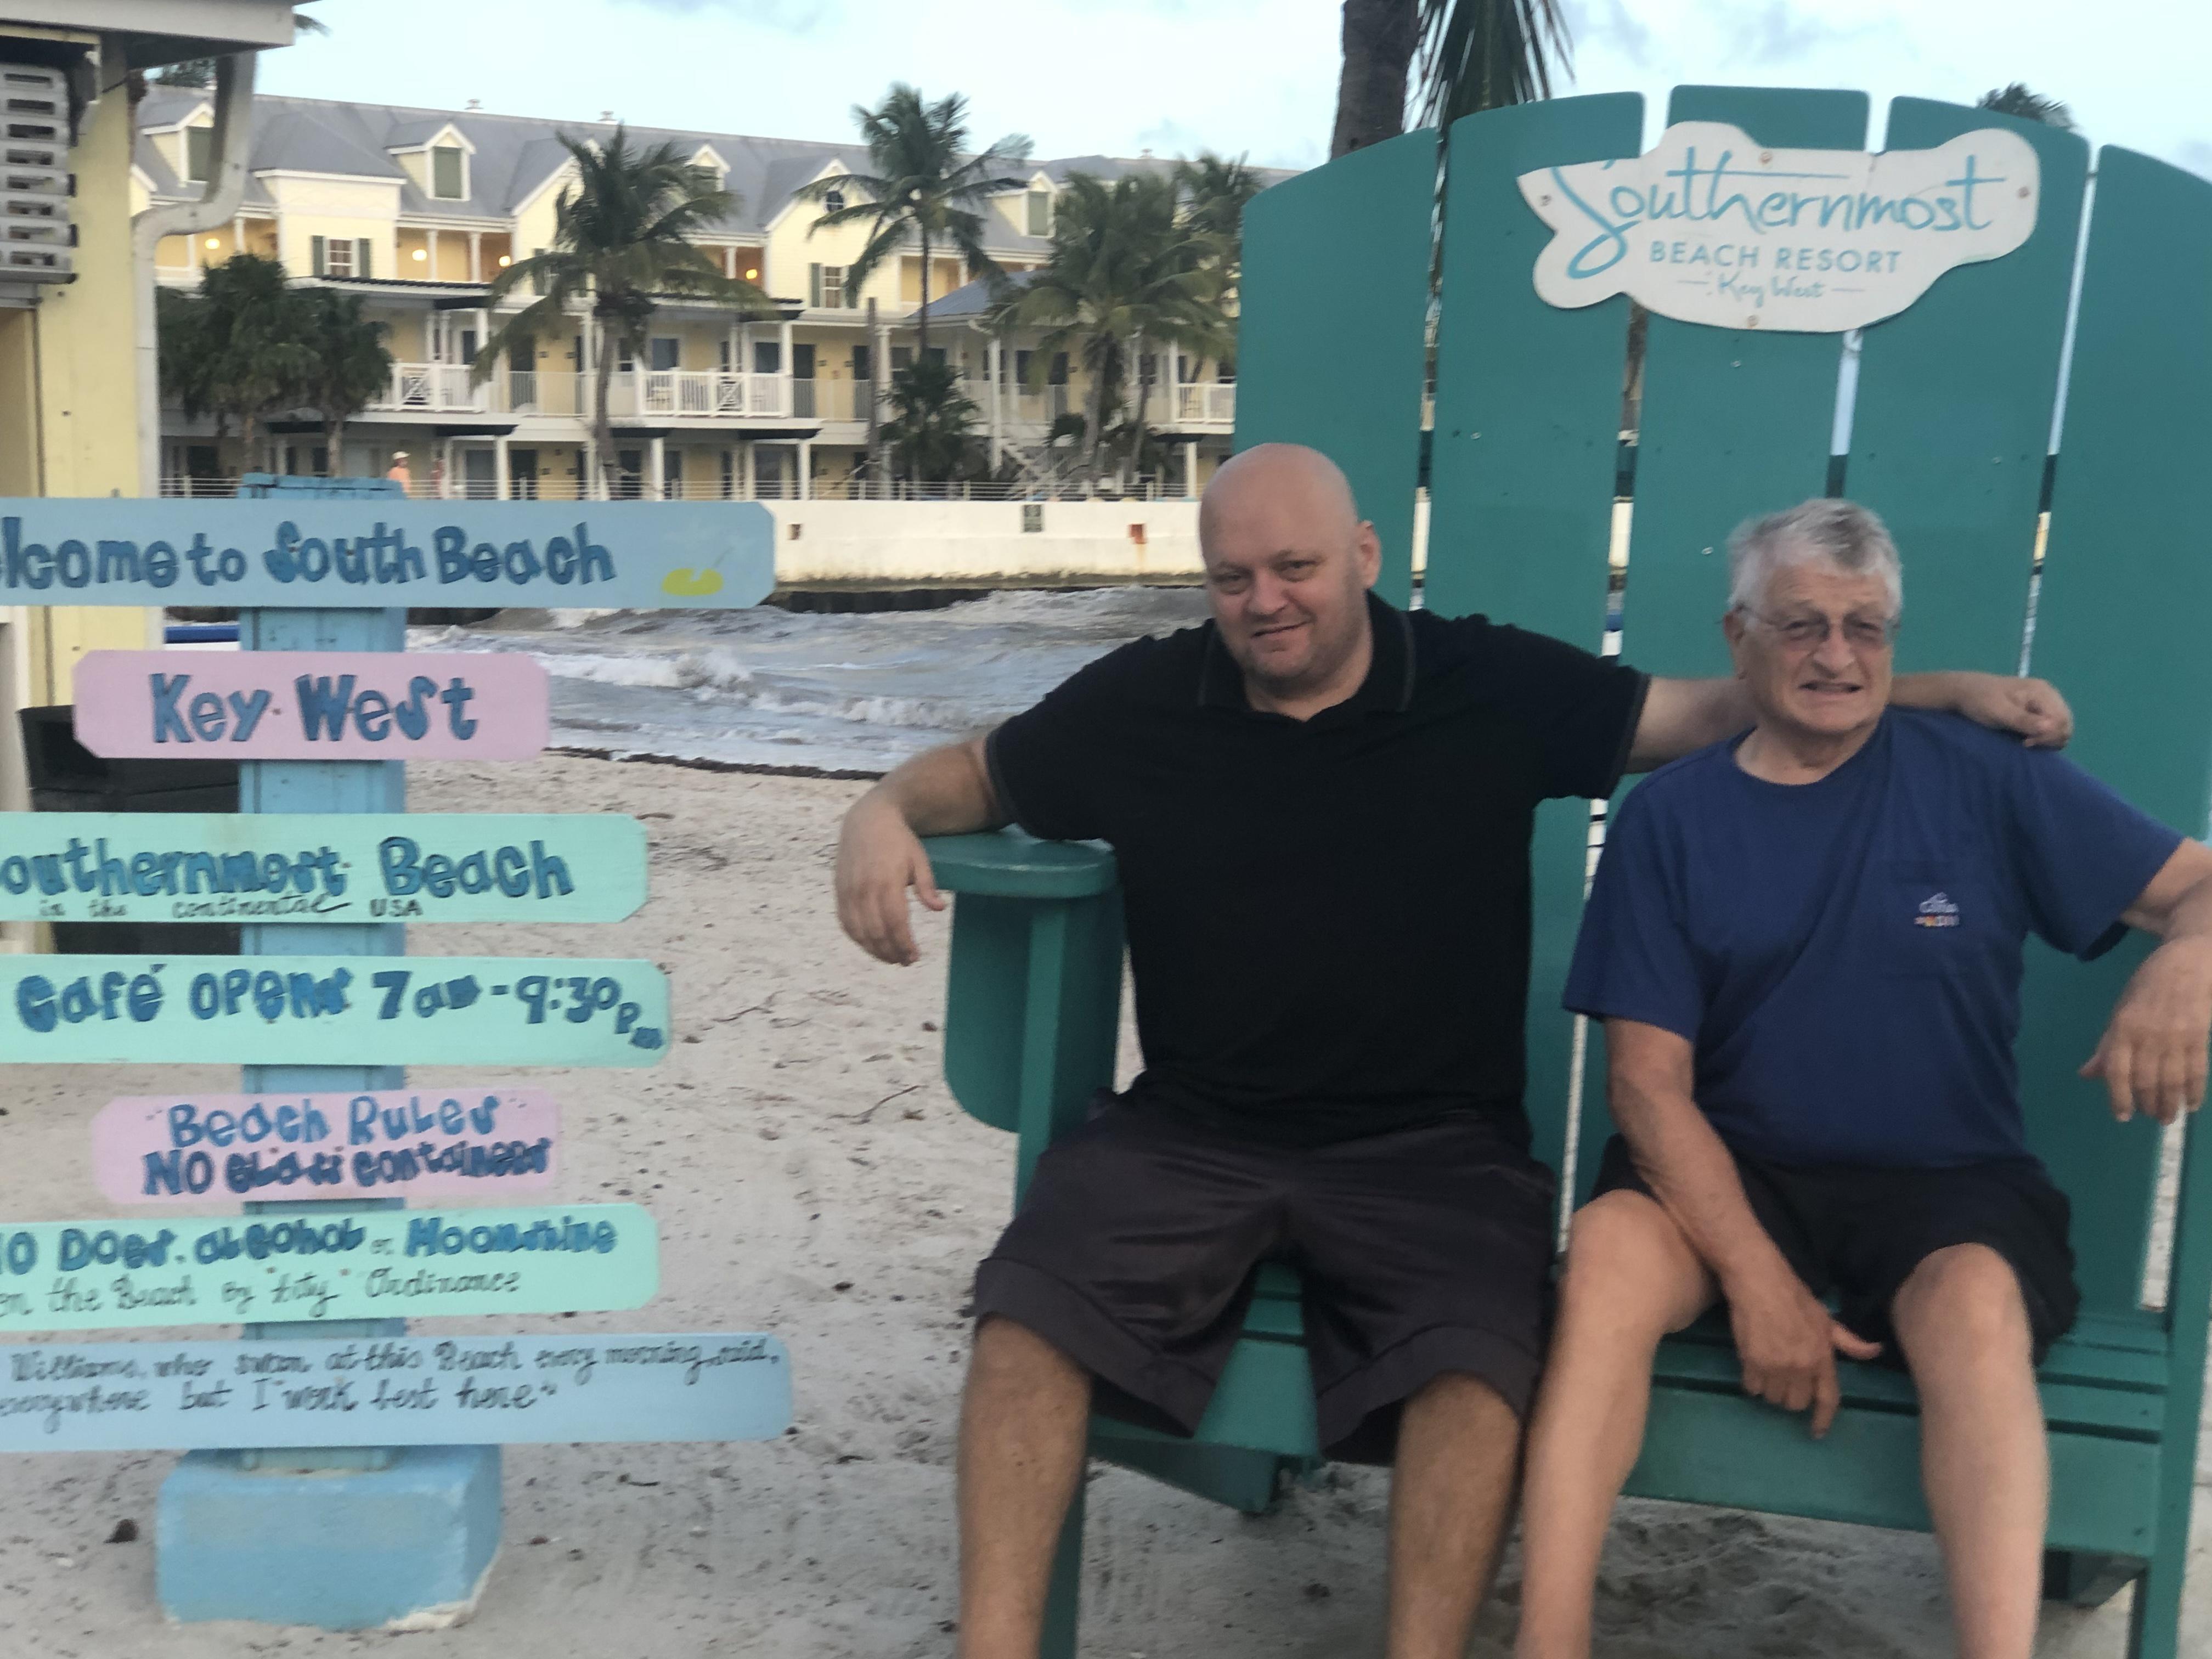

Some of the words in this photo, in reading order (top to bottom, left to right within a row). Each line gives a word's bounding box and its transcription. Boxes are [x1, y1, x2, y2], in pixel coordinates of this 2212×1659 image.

[1550, 146, 2007, 280] Southernmost
[1649, 240, 1759, 268] BEACH
[1775, 247, 1901, 273] RESORT
[1718, 272, 1764, 308] Key
[1771, 276, 1826, 298] West
[0, 516, 178, 590] lcome
[185, 533, 247, 586] to
[262, 521, 427, 585] South
[433, 521, 617, 585] Beach
[150, 673, 273, 743] Key
[294, 674, 478, 741] West
[380, 836, 575, 899] Beach
[89, 900, 127, 917] the
[370, 899, 424, 917] USA
[143, 1150, 215, 1195] NO
[0, 1232, 38, 1276] O
[46, 1277, 104, 1311] the
[179, 1380, 233, 1410] but
